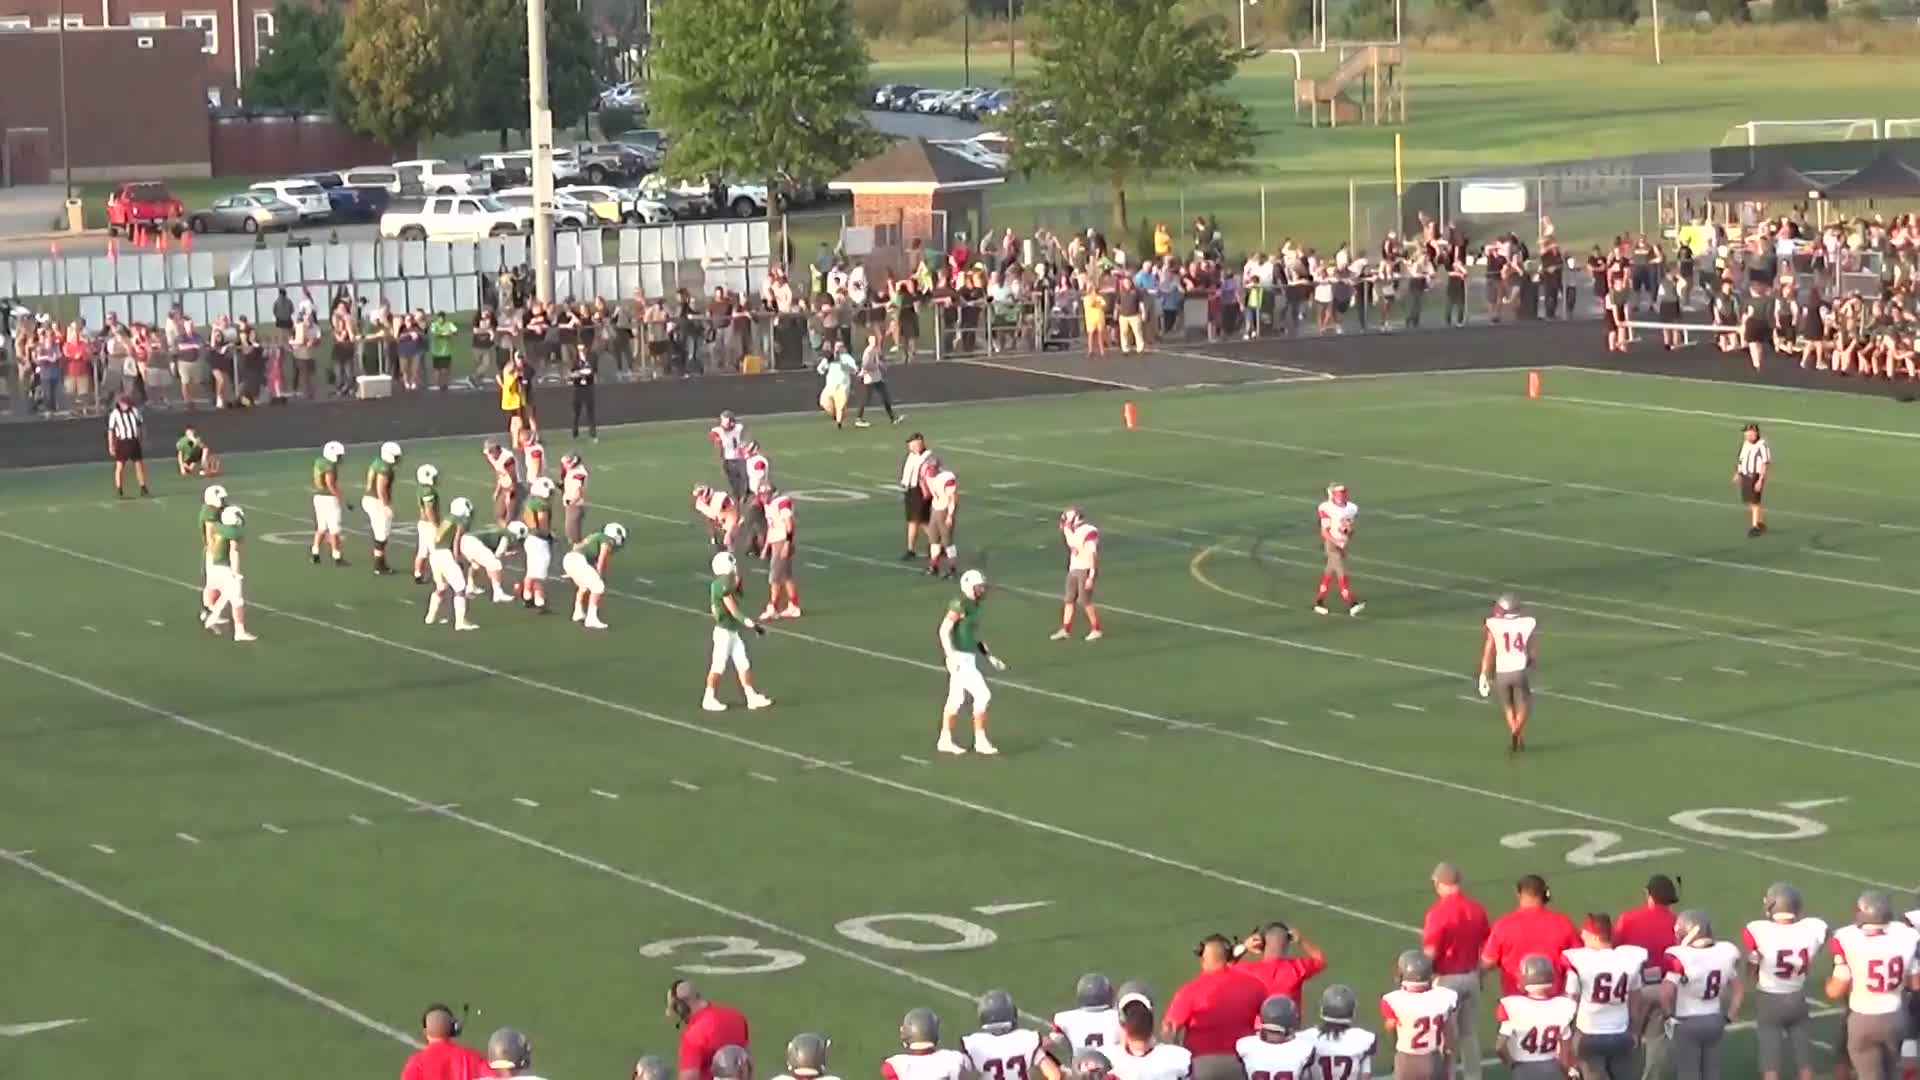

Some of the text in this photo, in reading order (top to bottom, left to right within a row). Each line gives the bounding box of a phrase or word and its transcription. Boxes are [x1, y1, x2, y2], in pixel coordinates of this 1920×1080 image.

[1503, 631, 1525, 653] 14
[1591, 972, 1629, 1004] 64
[1702, 969, 1722, 1001] 8
[1866, 955, 1905, 993] 59
[1411, 1013, 1446, 1049] 21
[1521, 1024, 1561, 1055] 48
